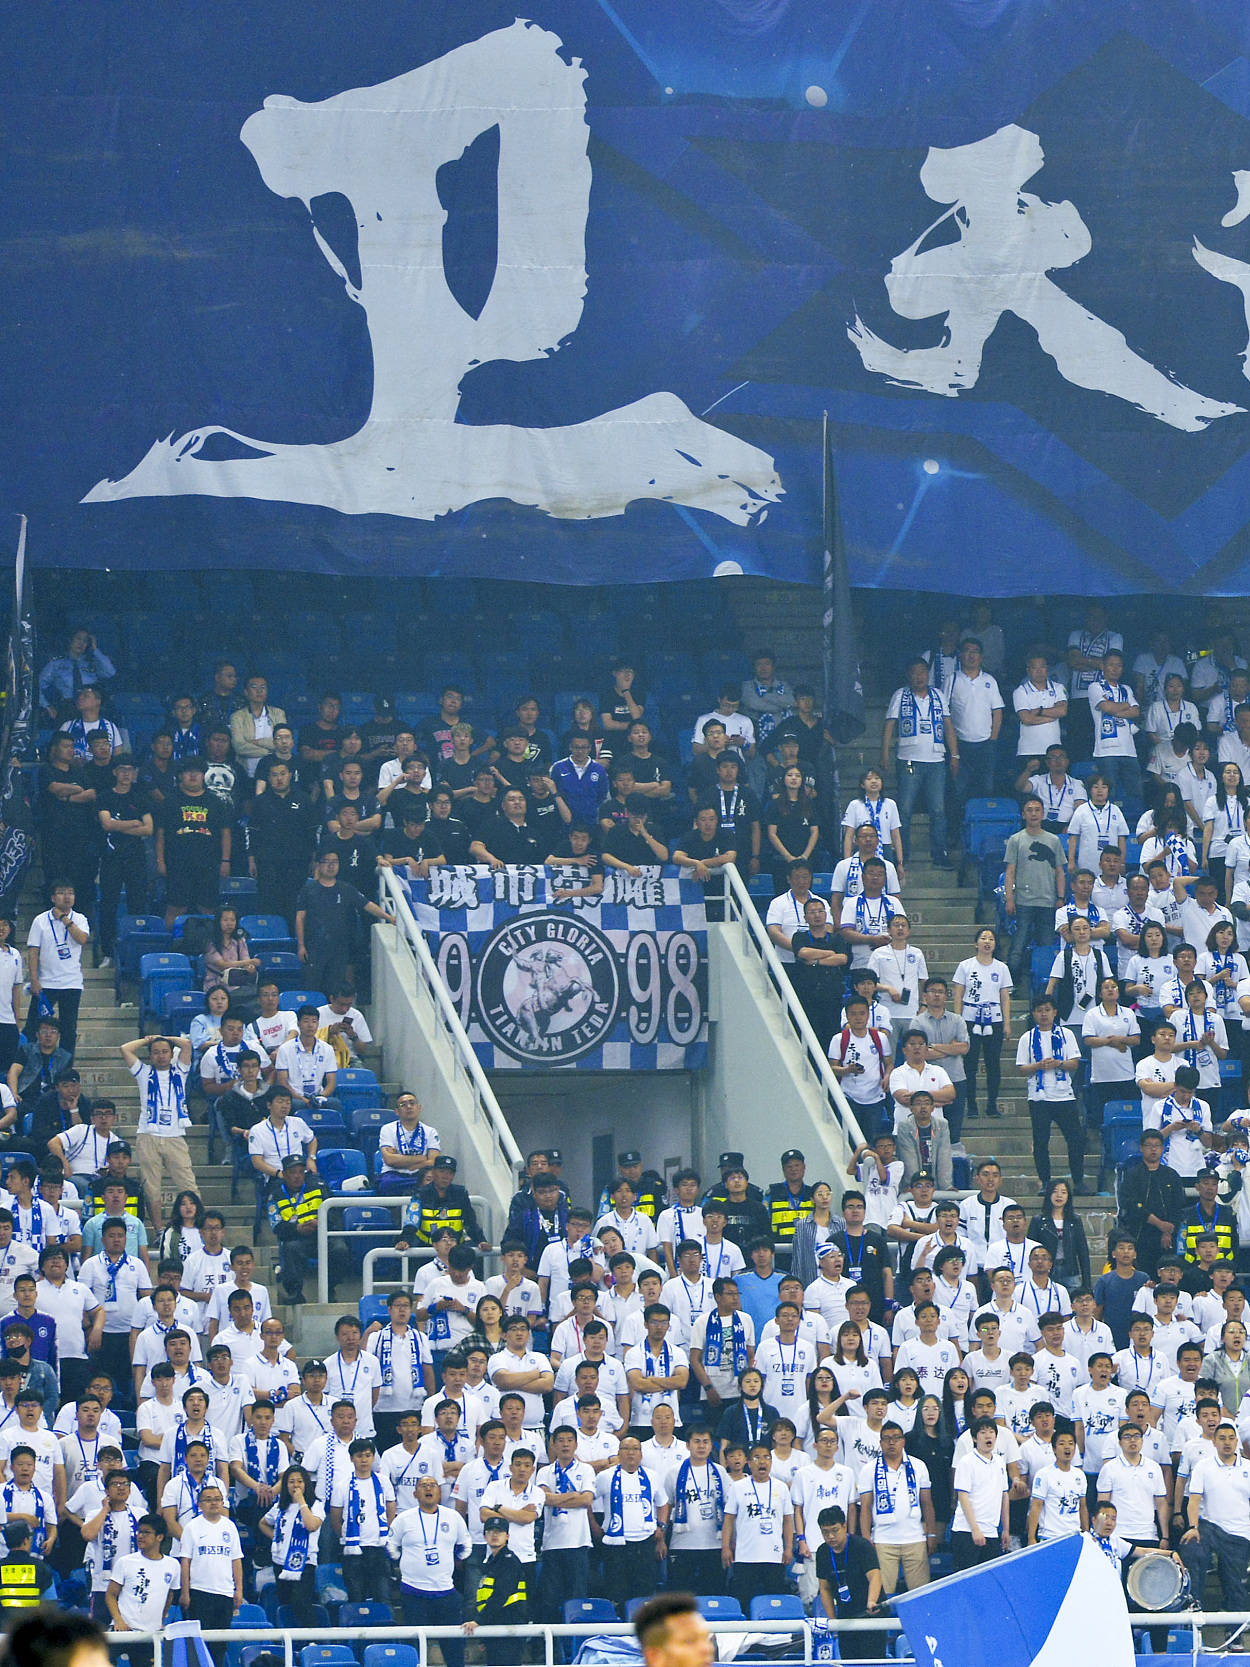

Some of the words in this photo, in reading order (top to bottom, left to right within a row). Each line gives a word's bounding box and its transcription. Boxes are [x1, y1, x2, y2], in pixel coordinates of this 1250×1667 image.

[429, 864, 664, 909] 城市荣耀
[497, 924, 538, 957] CITY
[546, 923, 604, 966] GLORIA
[627, 931, 700, 1045] 98
[489, 1003, 563, 1052] TIANJIN
[571, 1001, 609, 1045] TEDA
[161, 1193, 174, 1202] 13
[917, 1366, 945, 1380] 泰达
